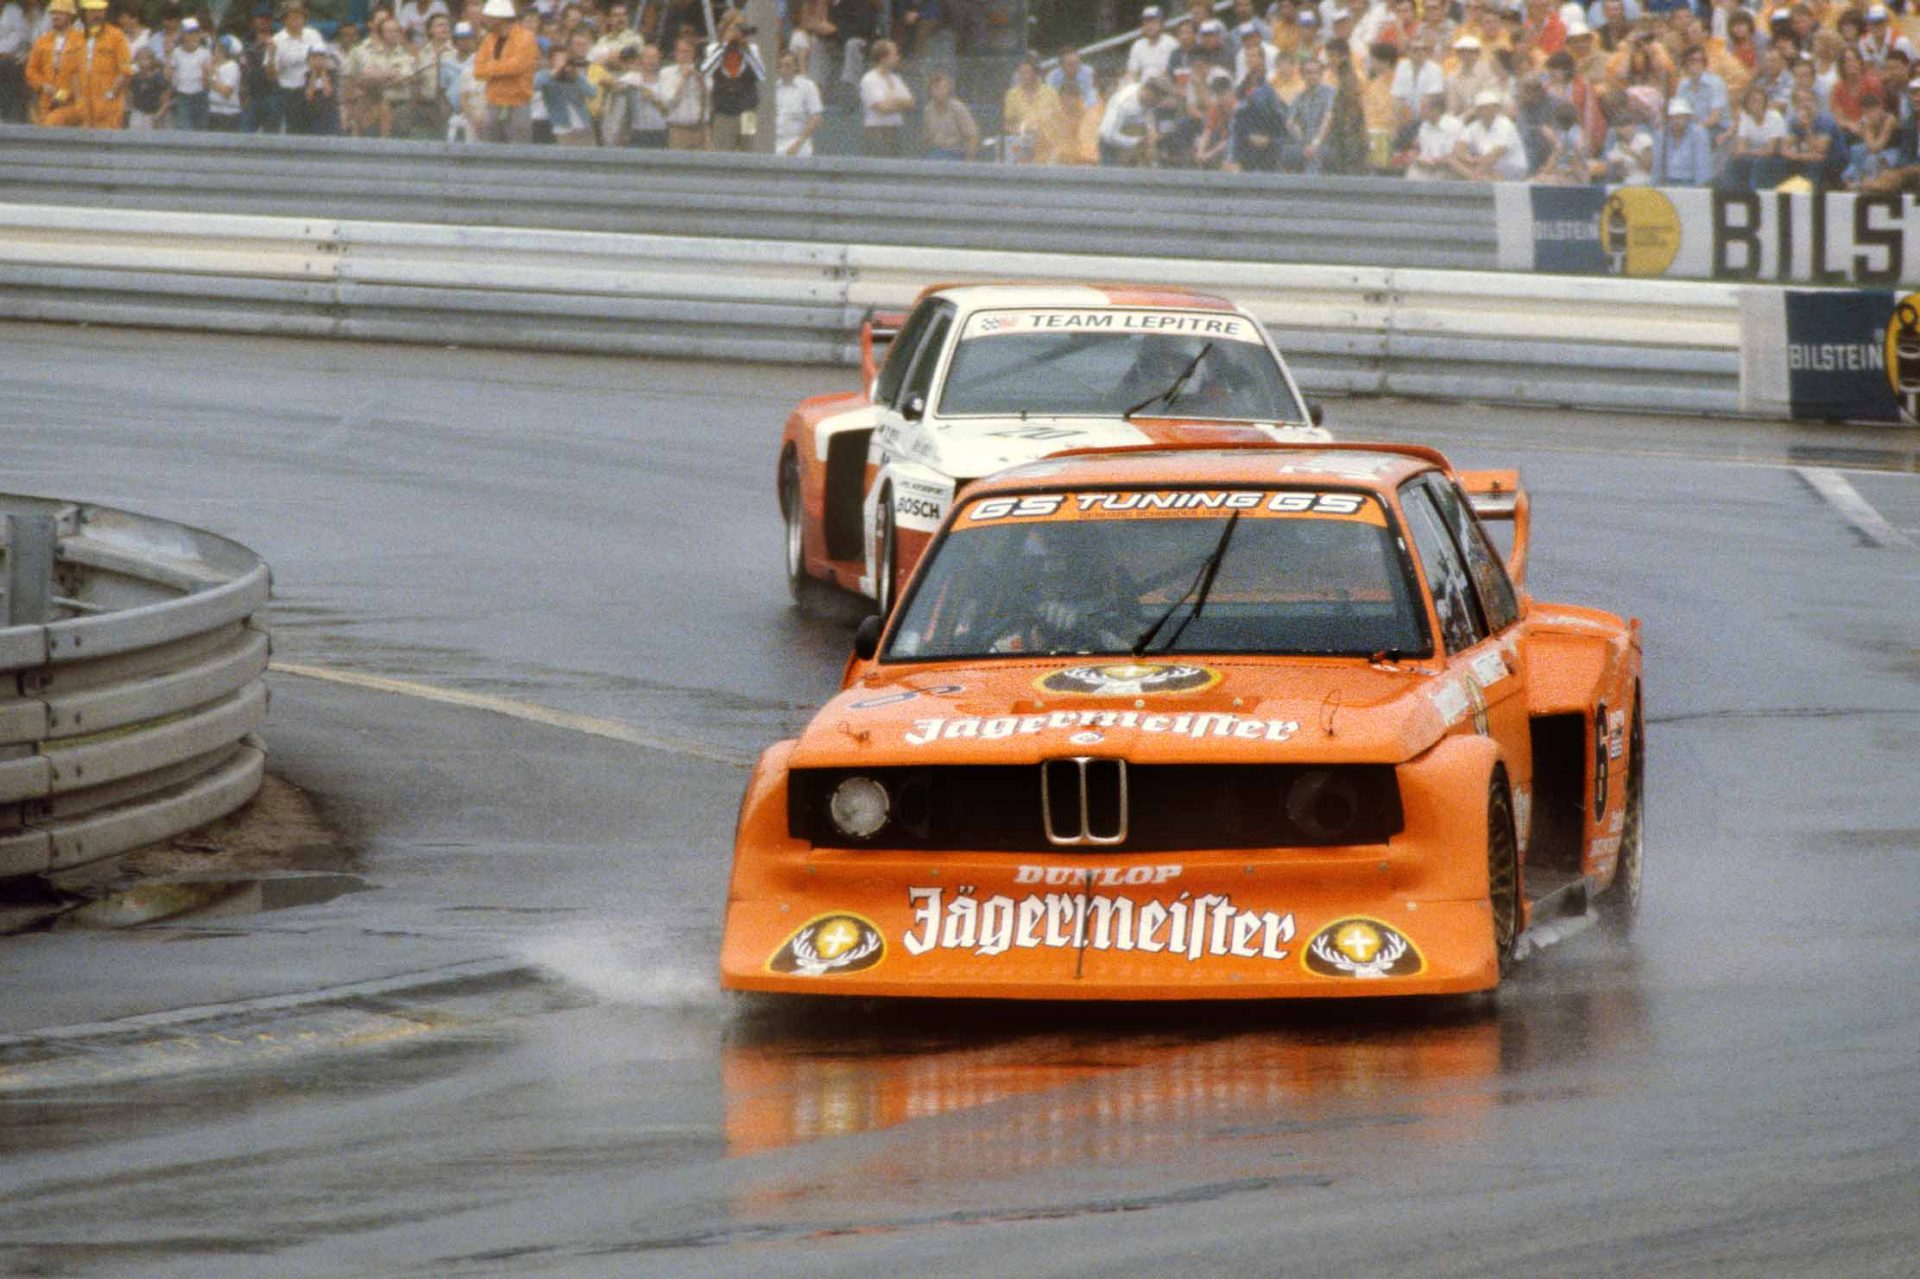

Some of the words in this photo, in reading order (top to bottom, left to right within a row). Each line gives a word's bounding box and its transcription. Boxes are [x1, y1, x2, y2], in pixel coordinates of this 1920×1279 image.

[1534, 220, 1599, 240] BILSTEIN
[1713, 188, 1920, 283] BILS
[1031, 314, 1111, 328] TEAM
[1124, 315, 1240, 335] LEPITRE
[1790, 344, 1884, 370] BILSTEIN
[896, 497, 941, 519] BOSCH
[969, 495, 1066, 520] GS
[1076, 492, 1265, 510] TUNING
[1267, 491, 1366, 515] GS
[1013, 865, 1184, 886] DUNLOP
[903, 886, 1297, 962] Jägermeister
